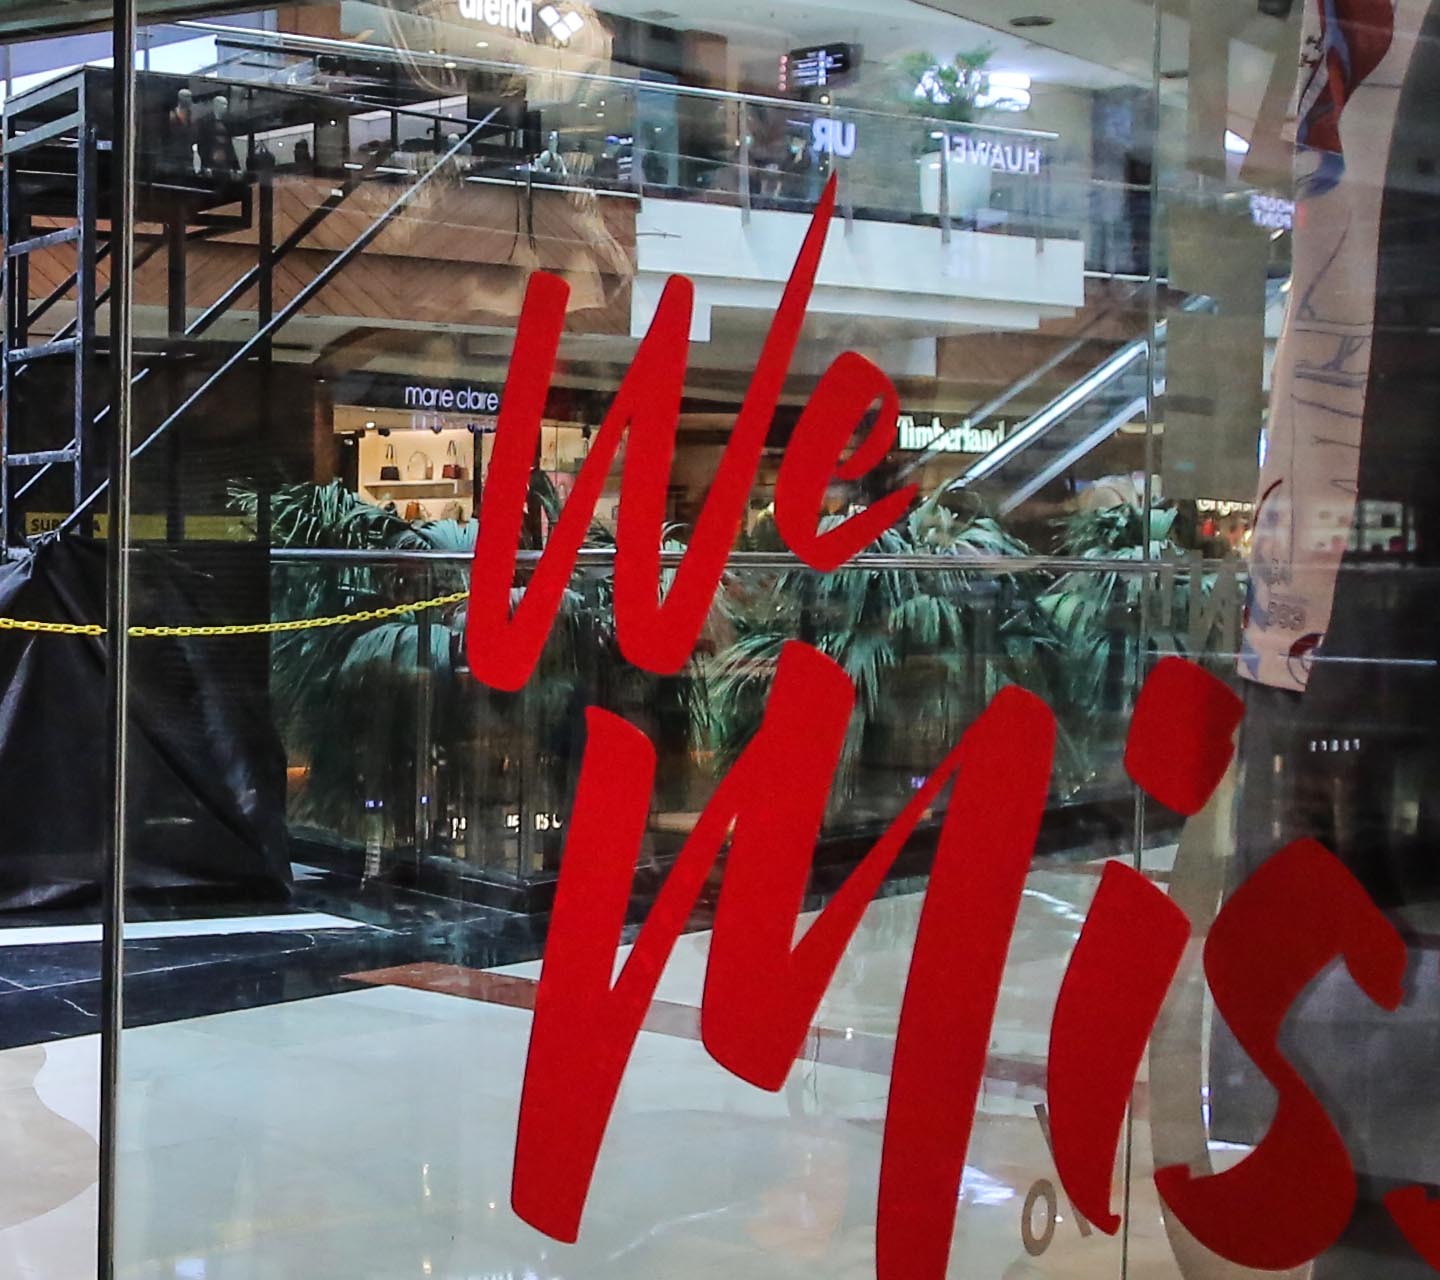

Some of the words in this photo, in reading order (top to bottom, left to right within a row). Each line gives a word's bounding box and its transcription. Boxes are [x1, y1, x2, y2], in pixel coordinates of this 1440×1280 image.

[404, 385, 454, 409] marie
[456, 386, 499, 412] claire
[465, 170, 917, 693] We
[897, 414, 1007, 454] Timberland
